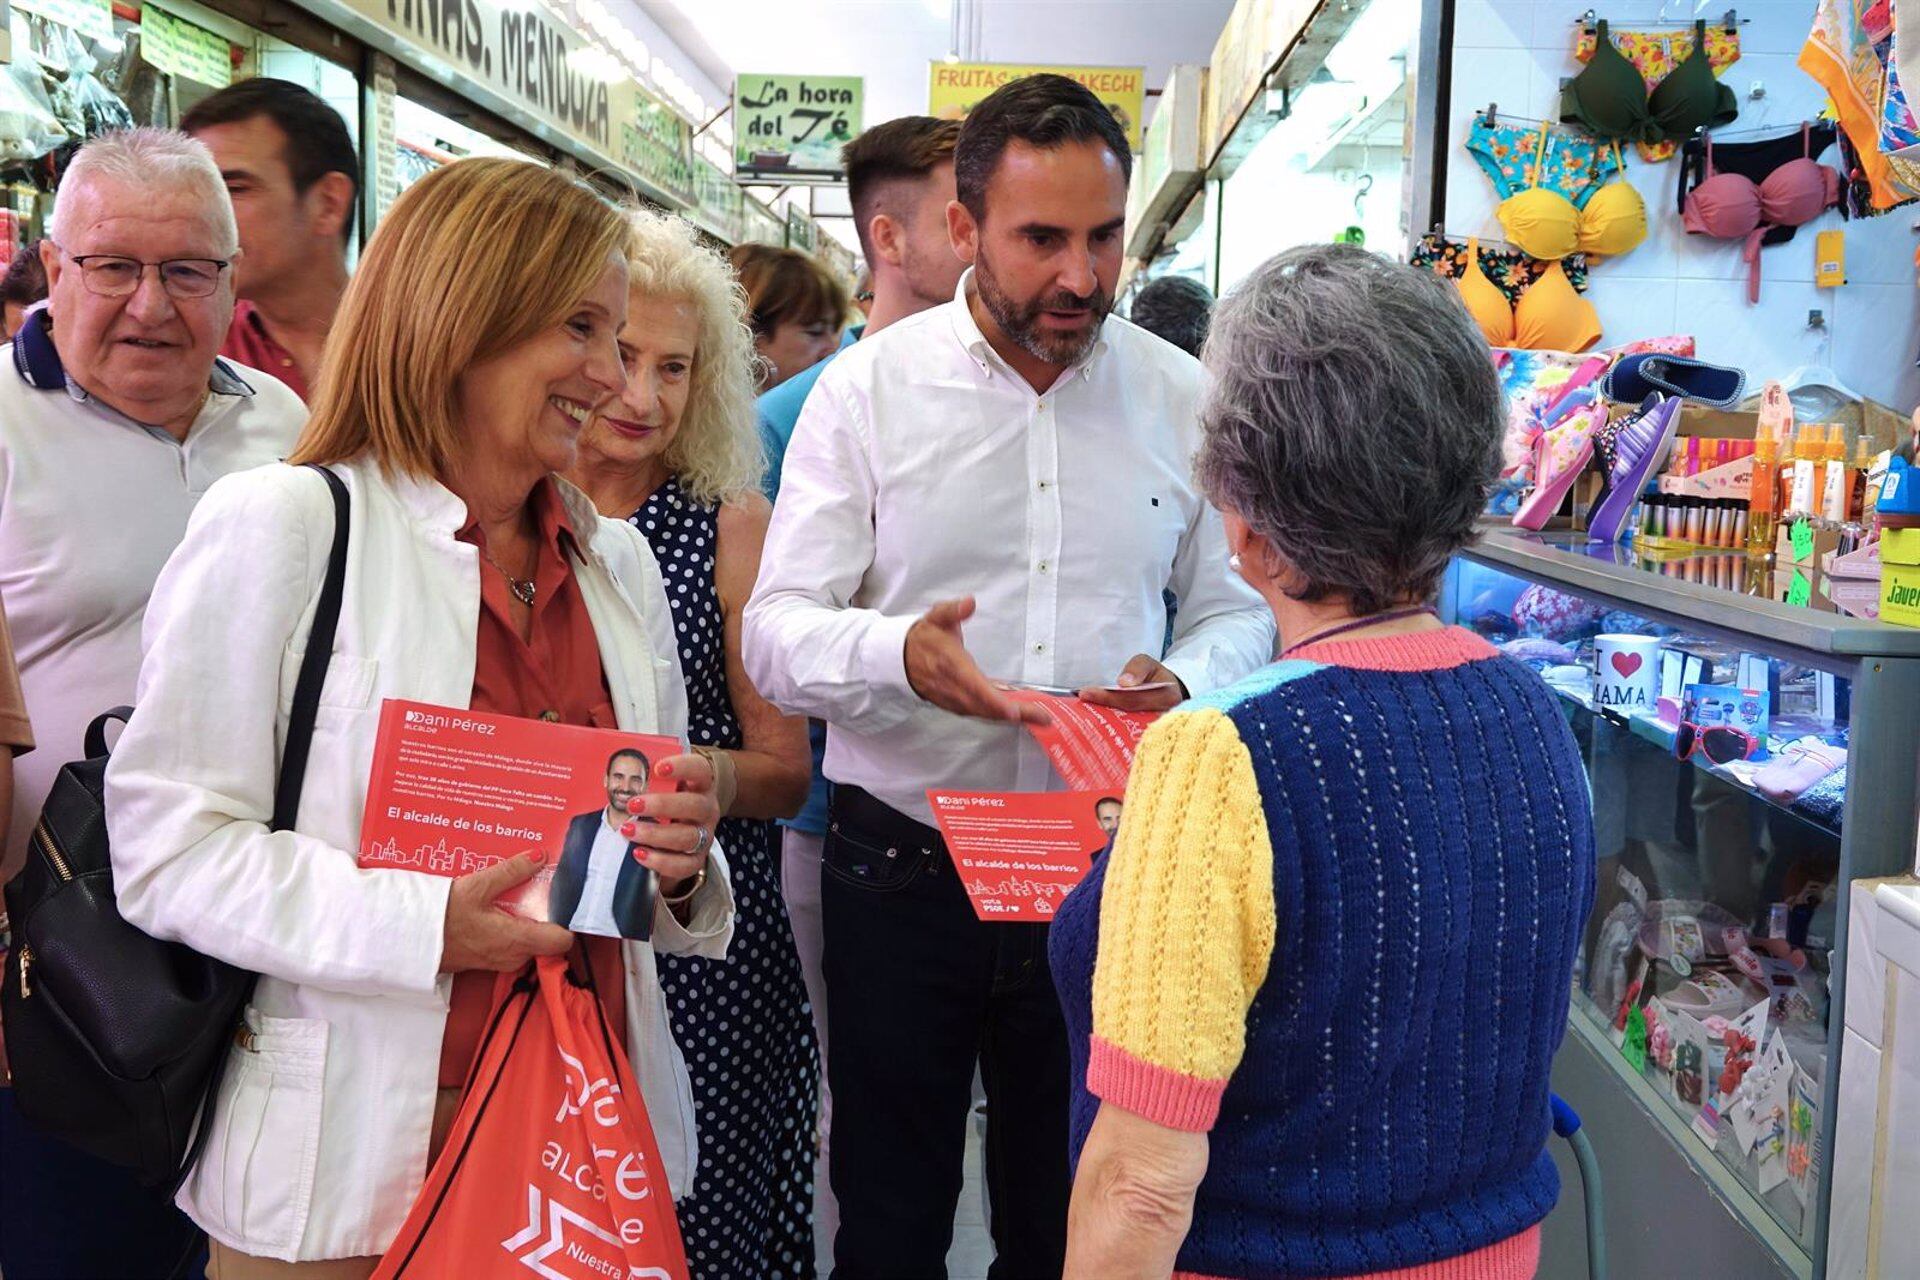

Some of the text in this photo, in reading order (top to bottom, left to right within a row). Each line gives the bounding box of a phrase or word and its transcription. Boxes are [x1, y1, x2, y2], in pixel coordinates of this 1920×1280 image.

[501, 8, 609, 149] MENDOZA
[740, 80, 853, 108] La hora
[748, 108, 849, 144] del Té
[1594, 648, 1602, 676] I
[406, 710, 497, 736] Dani Pérez
[388, 806, 543, 841] El alcalde de los barrios
[566, 1241, 622, 1280] Nuestra
